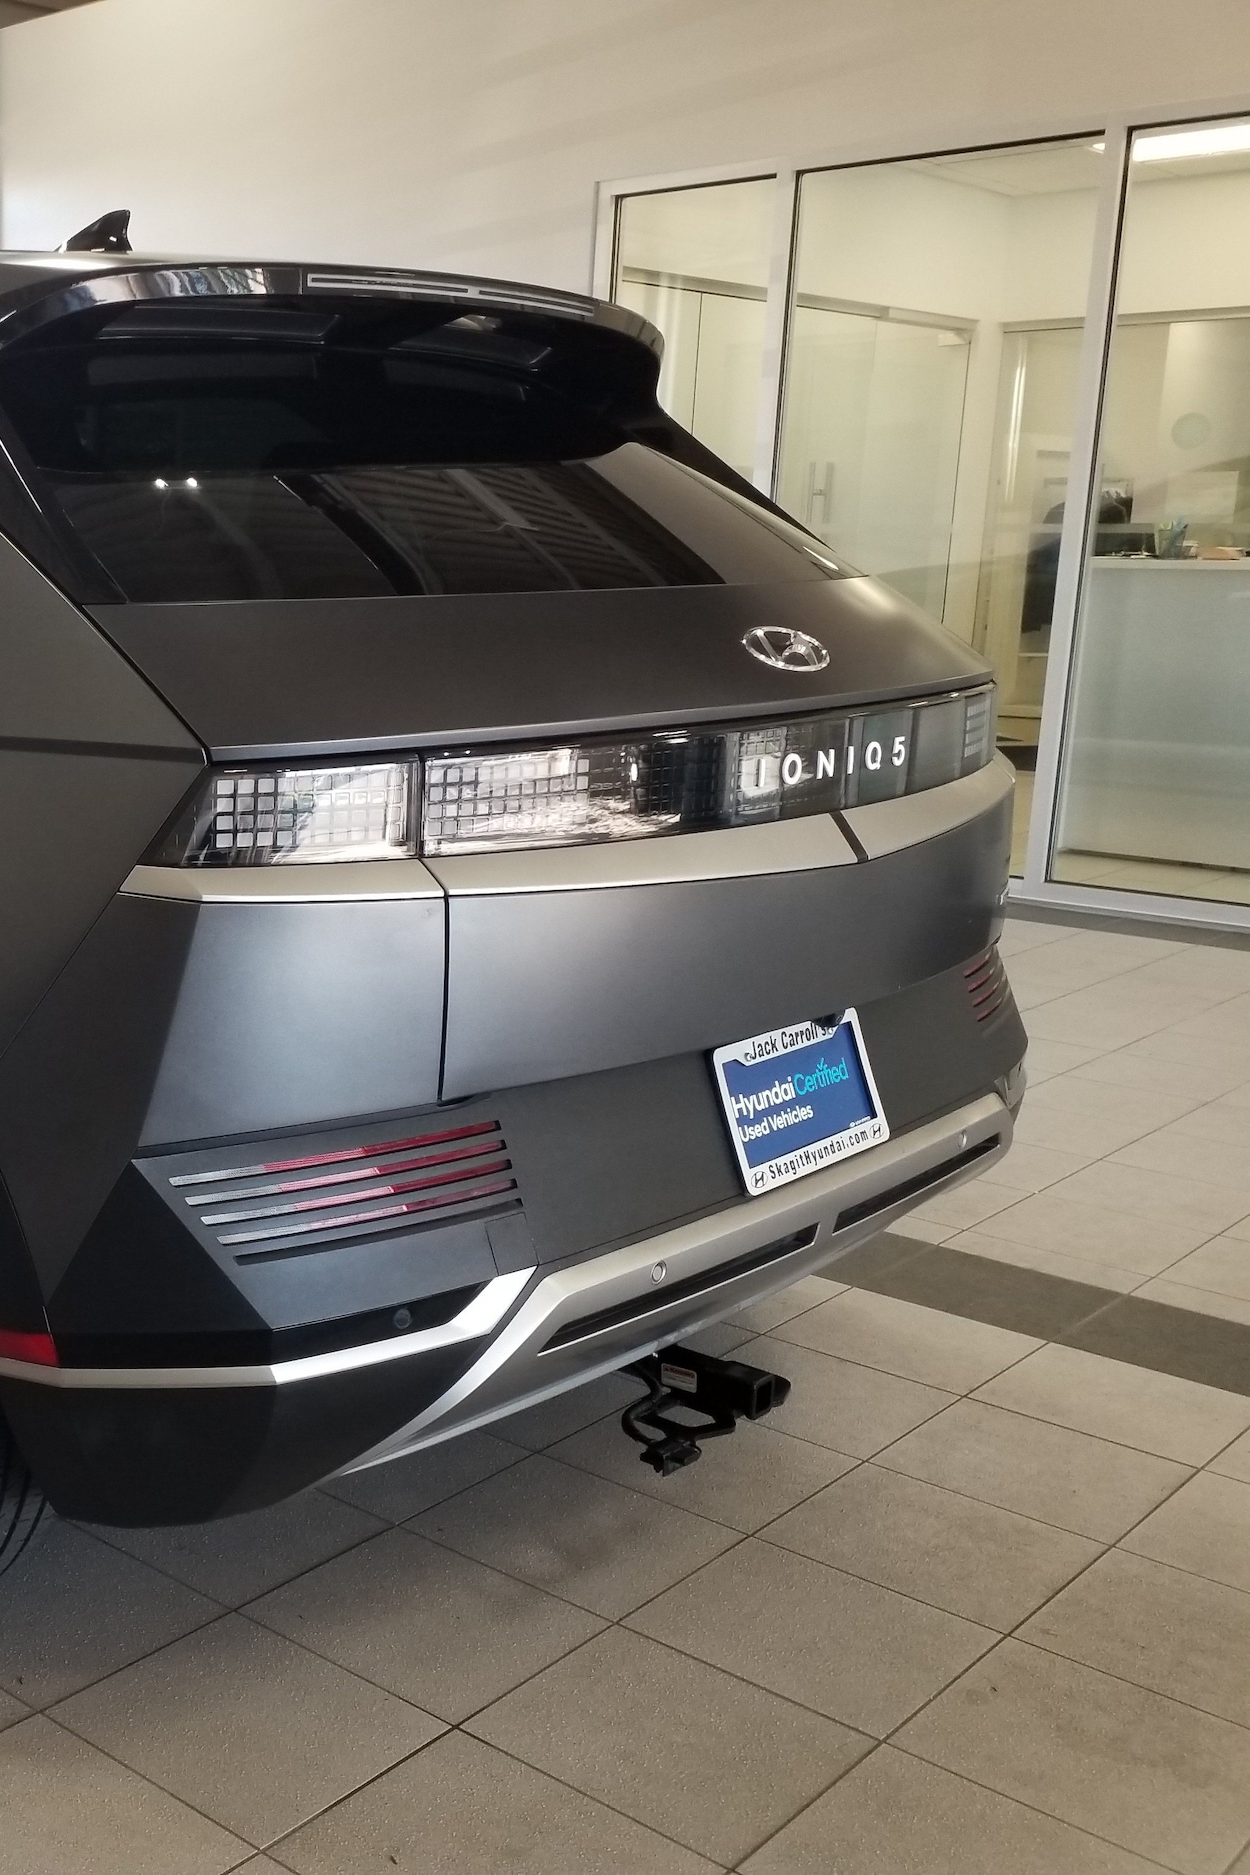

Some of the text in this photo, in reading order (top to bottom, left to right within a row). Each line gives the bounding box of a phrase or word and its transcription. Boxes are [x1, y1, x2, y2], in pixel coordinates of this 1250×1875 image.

[751, 1036, 779, 1060] Jack
[738, 1105, 814, 1142] Used Vehicles
[768, 1129, 869, 1180] SkagitHyundai.com
